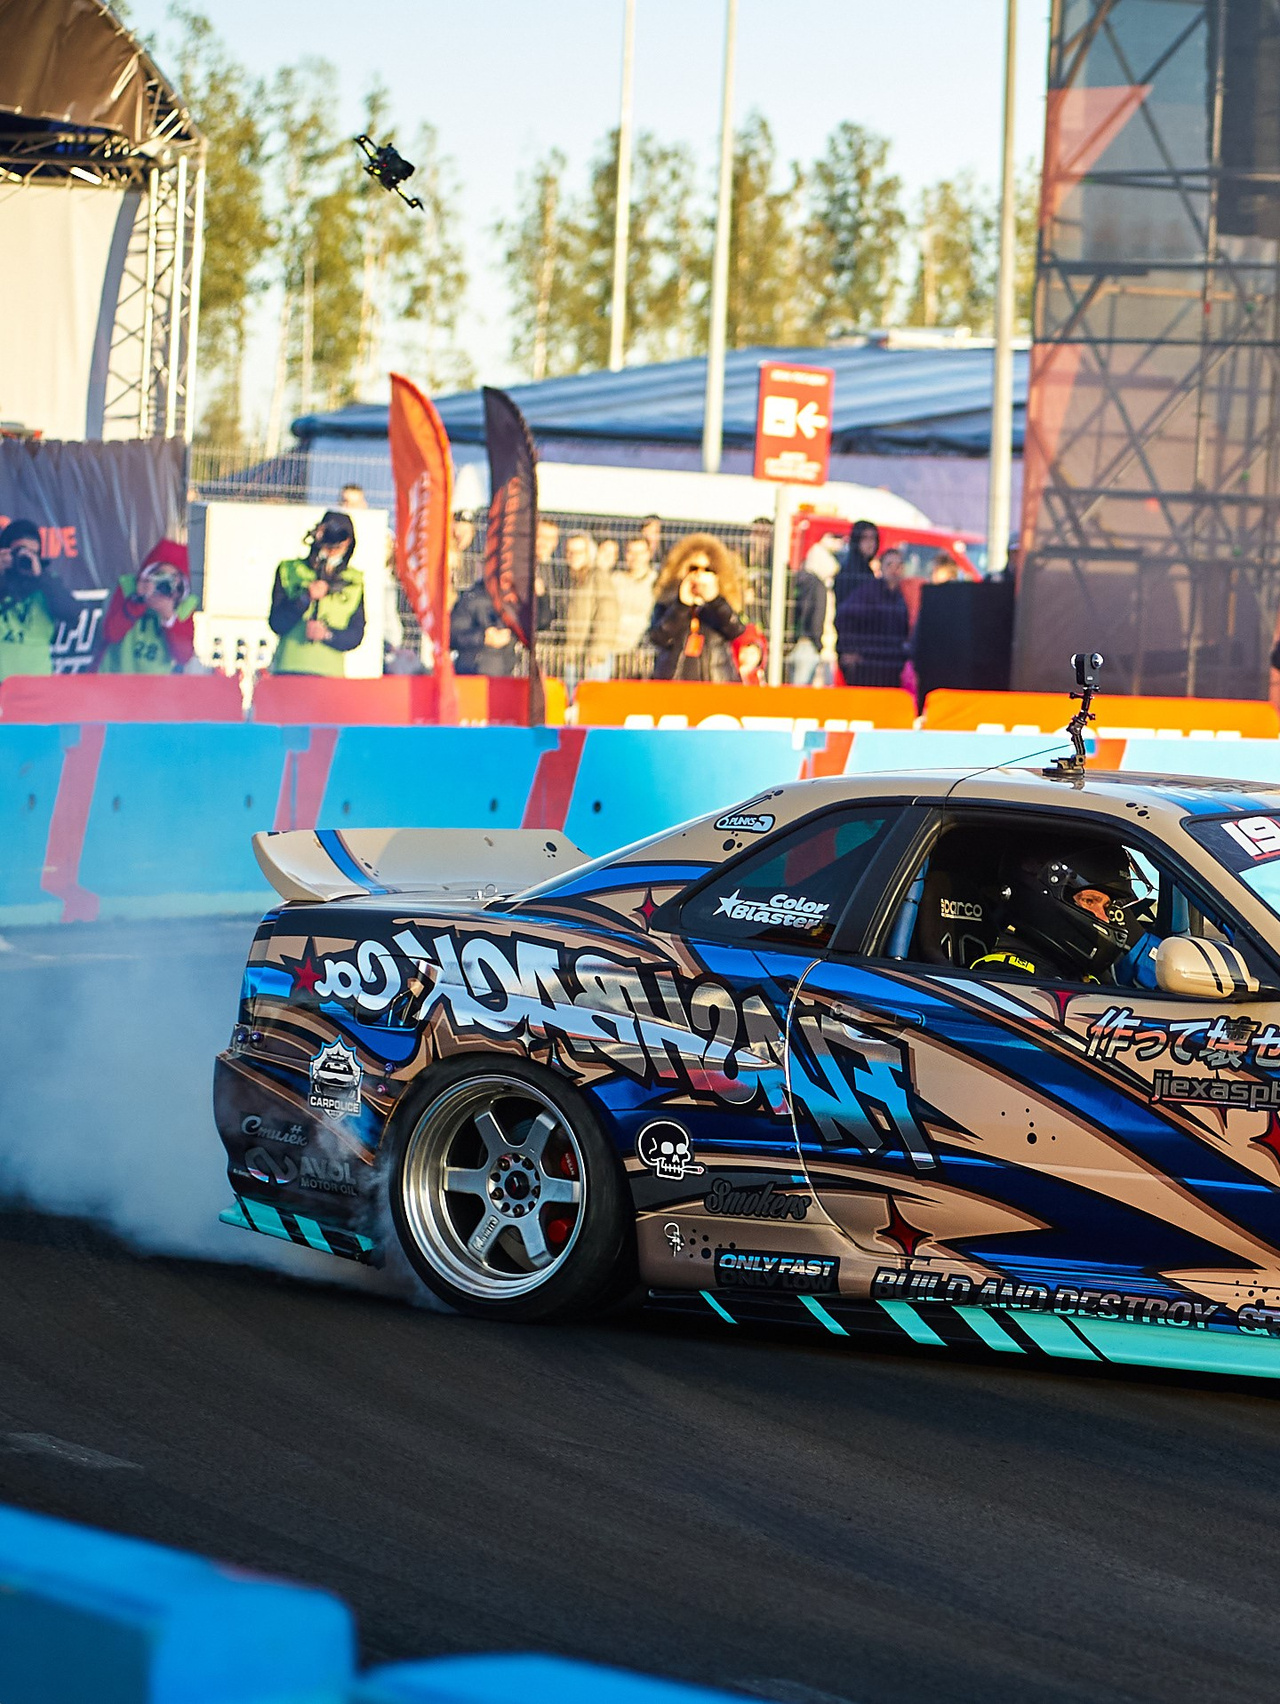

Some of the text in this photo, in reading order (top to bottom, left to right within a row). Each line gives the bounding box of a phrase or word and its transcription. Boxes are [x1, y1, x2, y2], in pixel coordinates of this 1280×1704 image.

[769, 893, 830, 914] Color
[730, 904, 821, 930] Blaster
[310, 1096, 360, 1114] CARPOLICE
[703, 1180, 813, 1221] Smokers
[719, 1253, 835, 1277] ONLY FAST
[872, 1270, 972, 1303] BUILD
[977, 1280, 1048, 1312] AND
[1053, 1287, 1219, 1329] DESTROY
